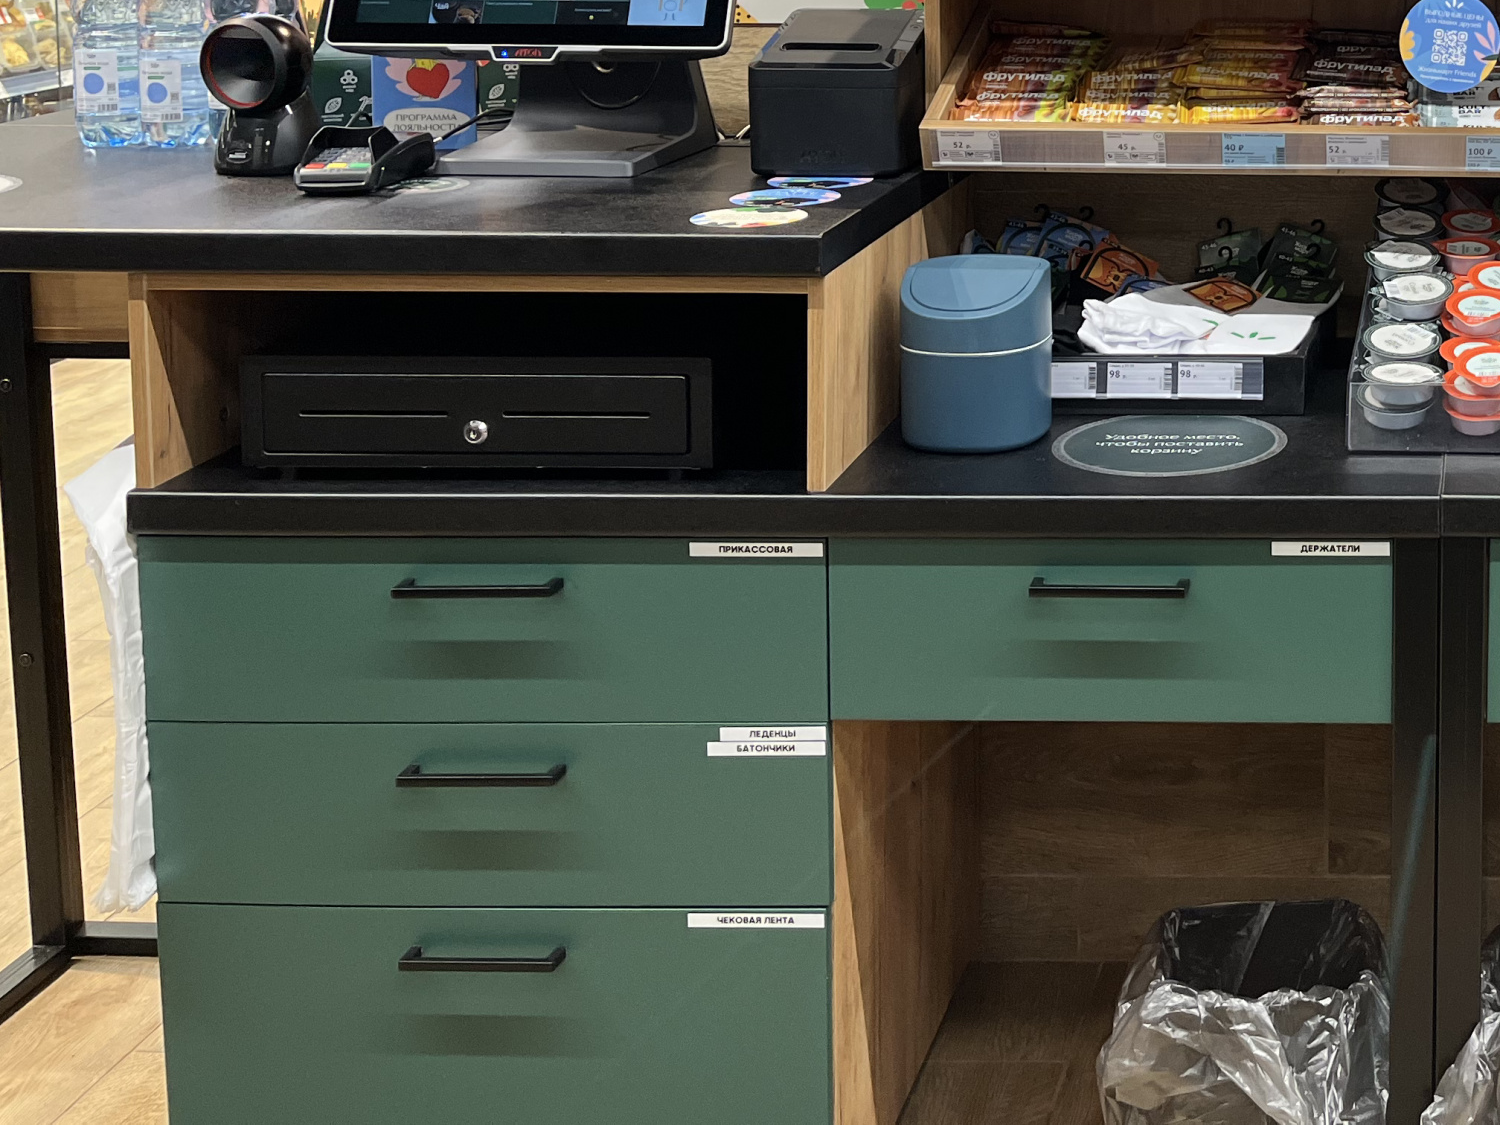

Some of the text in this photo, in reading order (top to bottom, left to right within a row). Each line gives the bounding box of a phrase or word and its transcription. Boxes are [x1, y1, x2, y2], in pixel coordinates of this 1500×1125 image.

[983, 71, 1066, 83] фрутилад
[976, 91, 1060, 101] фрутилад
[395, 113, 457, 123] ПРОГРАММА
[1079, 107, 1163, 120] фрутилад
[952, 141, 964, 149] 52
[1118, 143, 1128, 151] 45
[1224, 143, 1236, 151] 40
[1328, 145, 1340, 154] 52
[1468, 148, 1485, 157] 100
[1109, 369, 1121, 379] 98
[1180, 369, 1192, 379] 98
[1105, 433, 1240, 441] Удобное место,
[718, 545, 794, 554] ПРИКАССОВАЯ
[1300, 545, 1360, 553] ДЕРЖАТЕЛИ
[749, 730, 796, 739] ЛЕДЕНЦЫ
[736, 745, 796, 753] БАТОНЧИКИ
[717, 916, 795, 925] ЧЕКОВАЯ ЛЕНТА
